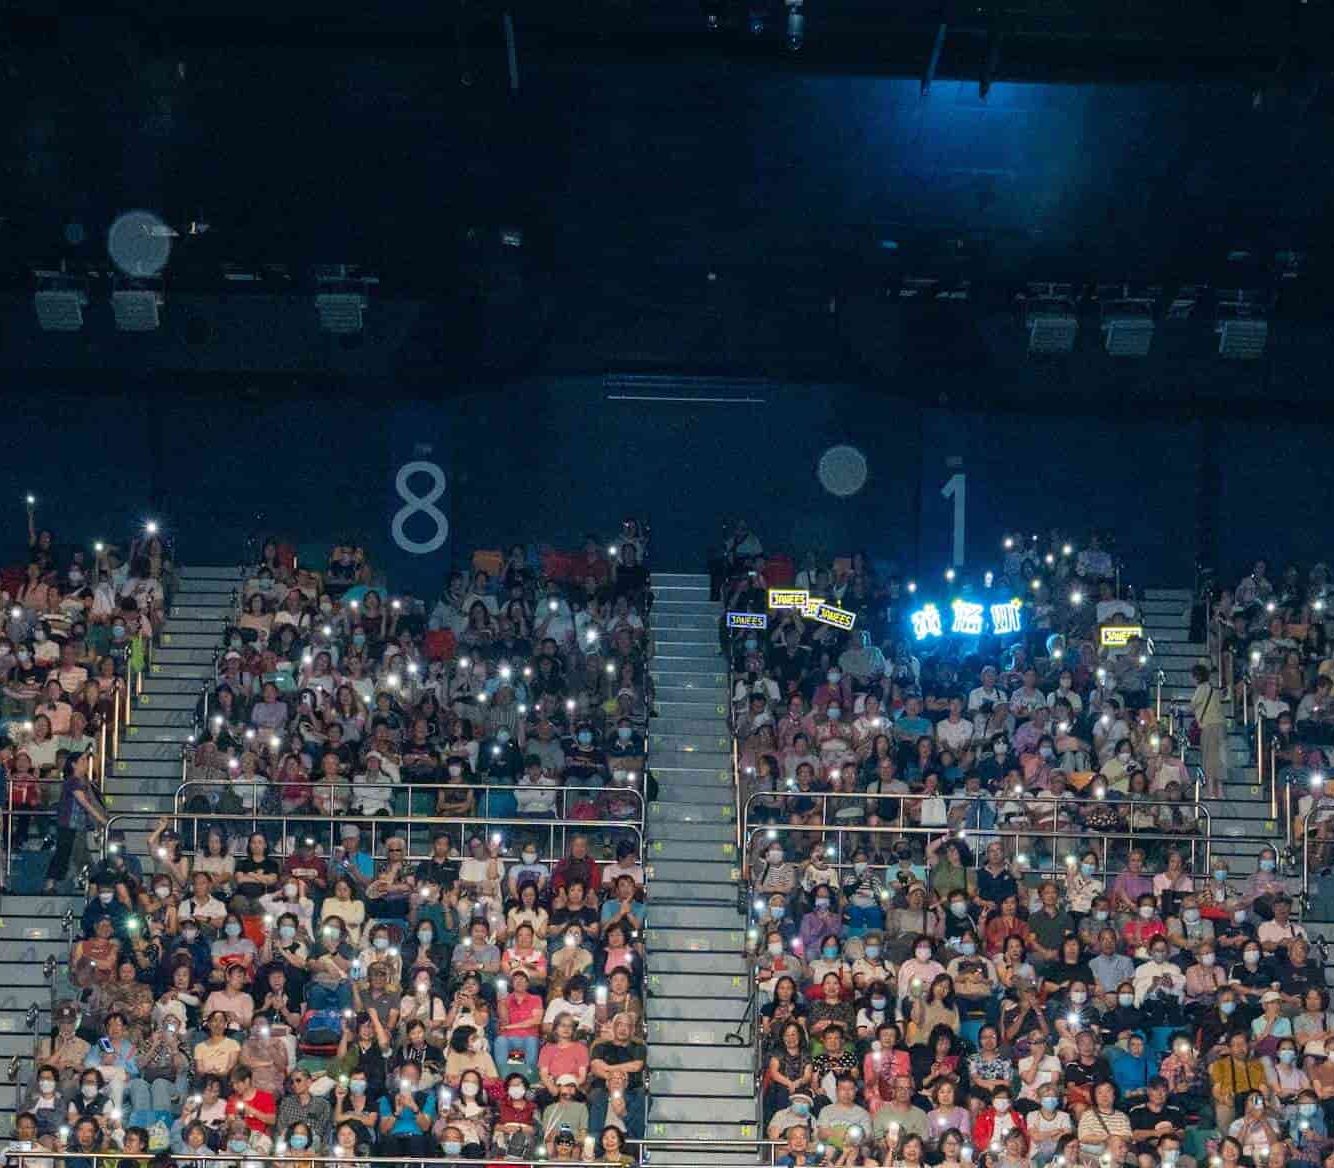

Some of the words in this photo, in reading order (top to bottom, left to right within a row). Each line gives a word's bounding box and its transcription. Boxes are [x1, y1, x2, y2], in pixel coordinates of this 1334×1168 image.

[391, 461, 448, 553] 8
[941, 474, 965, 566] 1
[731, 616, 763, 626] JANEES
[821, 608, 851, 626] JANEES
